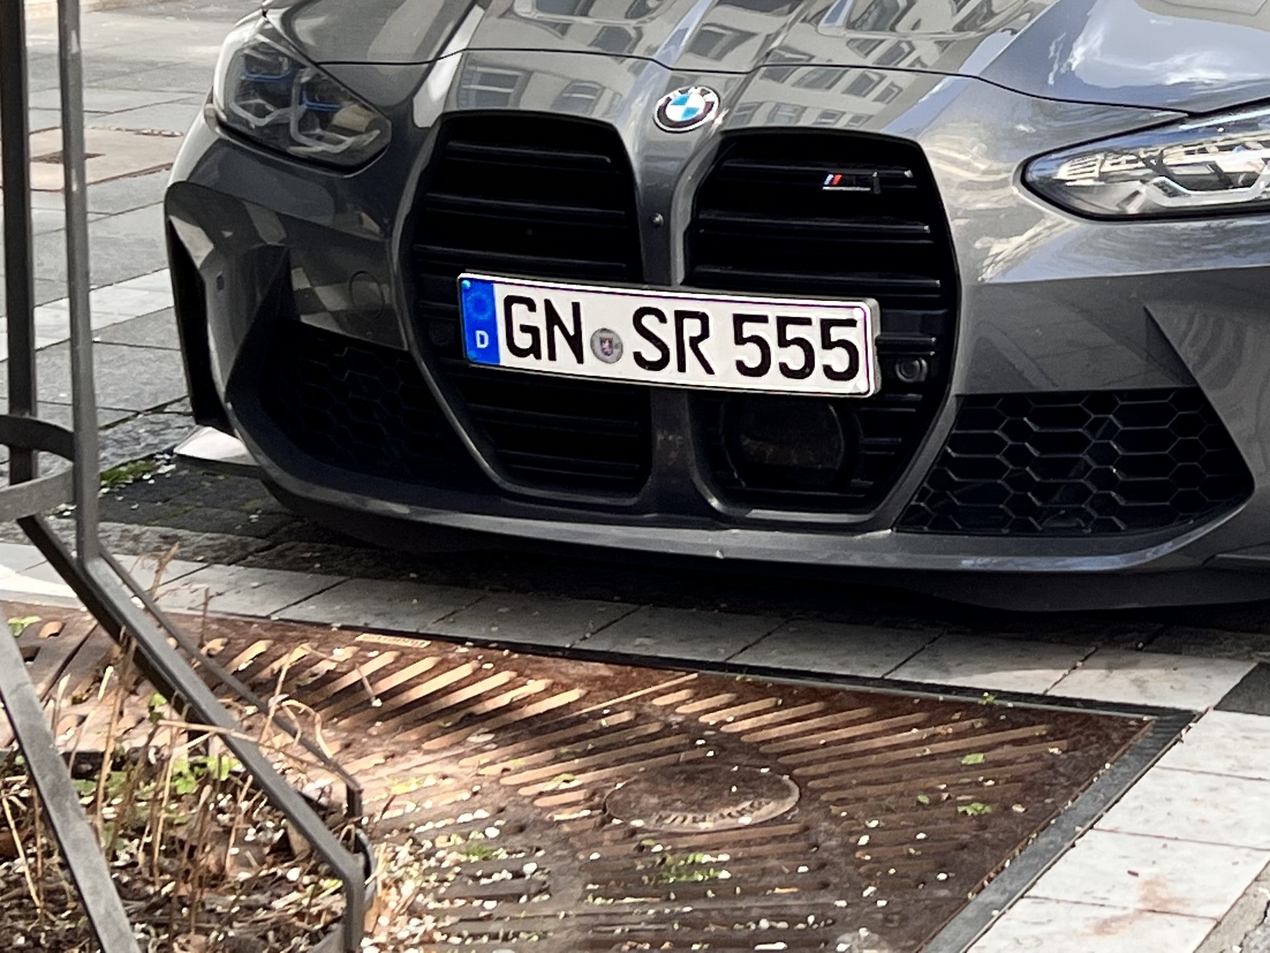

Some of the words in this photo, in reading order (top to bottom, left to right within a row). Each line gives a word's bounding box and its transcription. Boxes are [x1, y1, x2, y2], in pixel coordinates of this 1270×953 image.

[476, 331, 489, 349] D
[503, 295, 584, 365] GN
[632, 306, 716, 376] SR
[732, 313, 860, 382] 555
